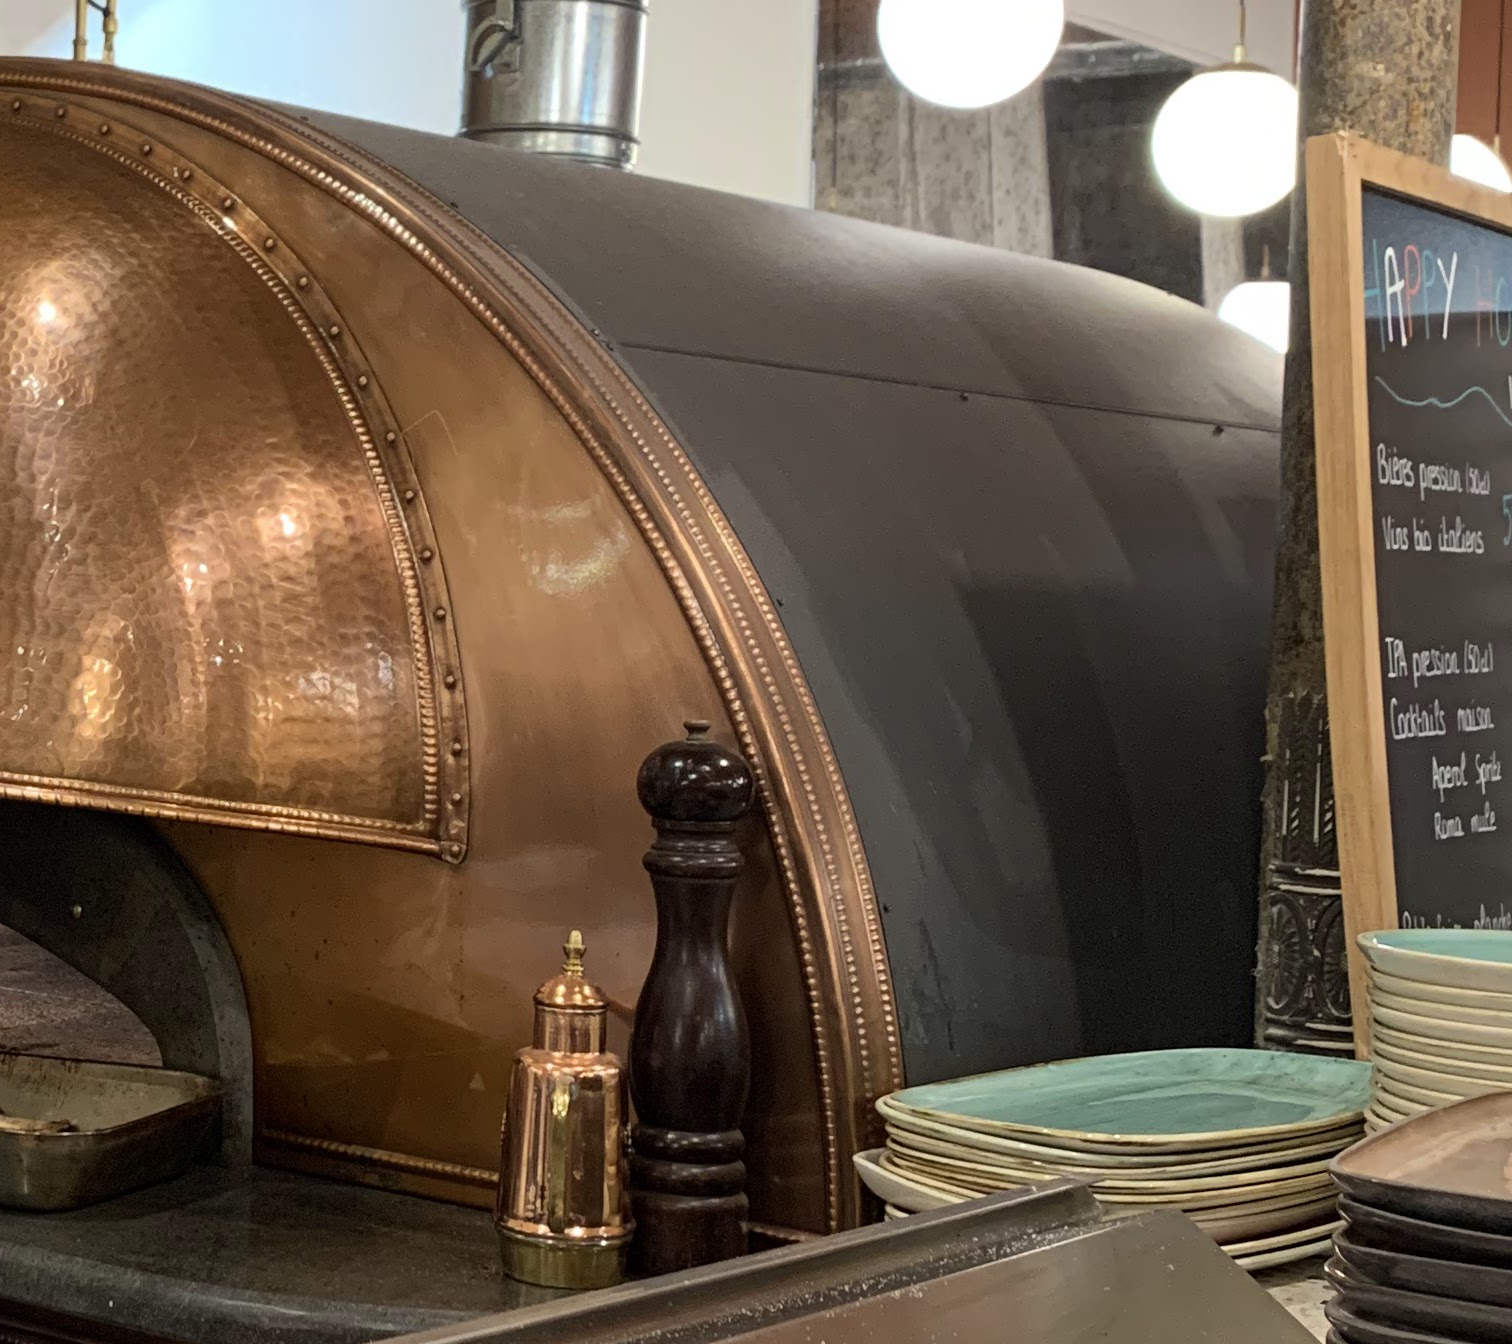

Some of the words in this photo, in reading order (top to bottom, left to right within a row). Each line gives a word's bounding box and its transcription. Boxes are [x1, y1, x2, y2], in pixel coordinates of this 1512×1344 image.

[1364, 238, 1458, 353] HAPPY
[1419, 462, 1463, 501] pression
[1382, 515, 1409, 551] Vins
[1413, 517, 1432, 552] bio
[1437, 516, 1485, 554] italiens
[1385, 637, 1408, 678] IPA
[1412, 645, 1460, 689] pression
[1390, 697, 1446, 740] Cocktails
[1456, 699, 1495, 732] maison
[1432, 751, 1469, 803] Aperol
[1434, 812, 1466, 841] Roma
